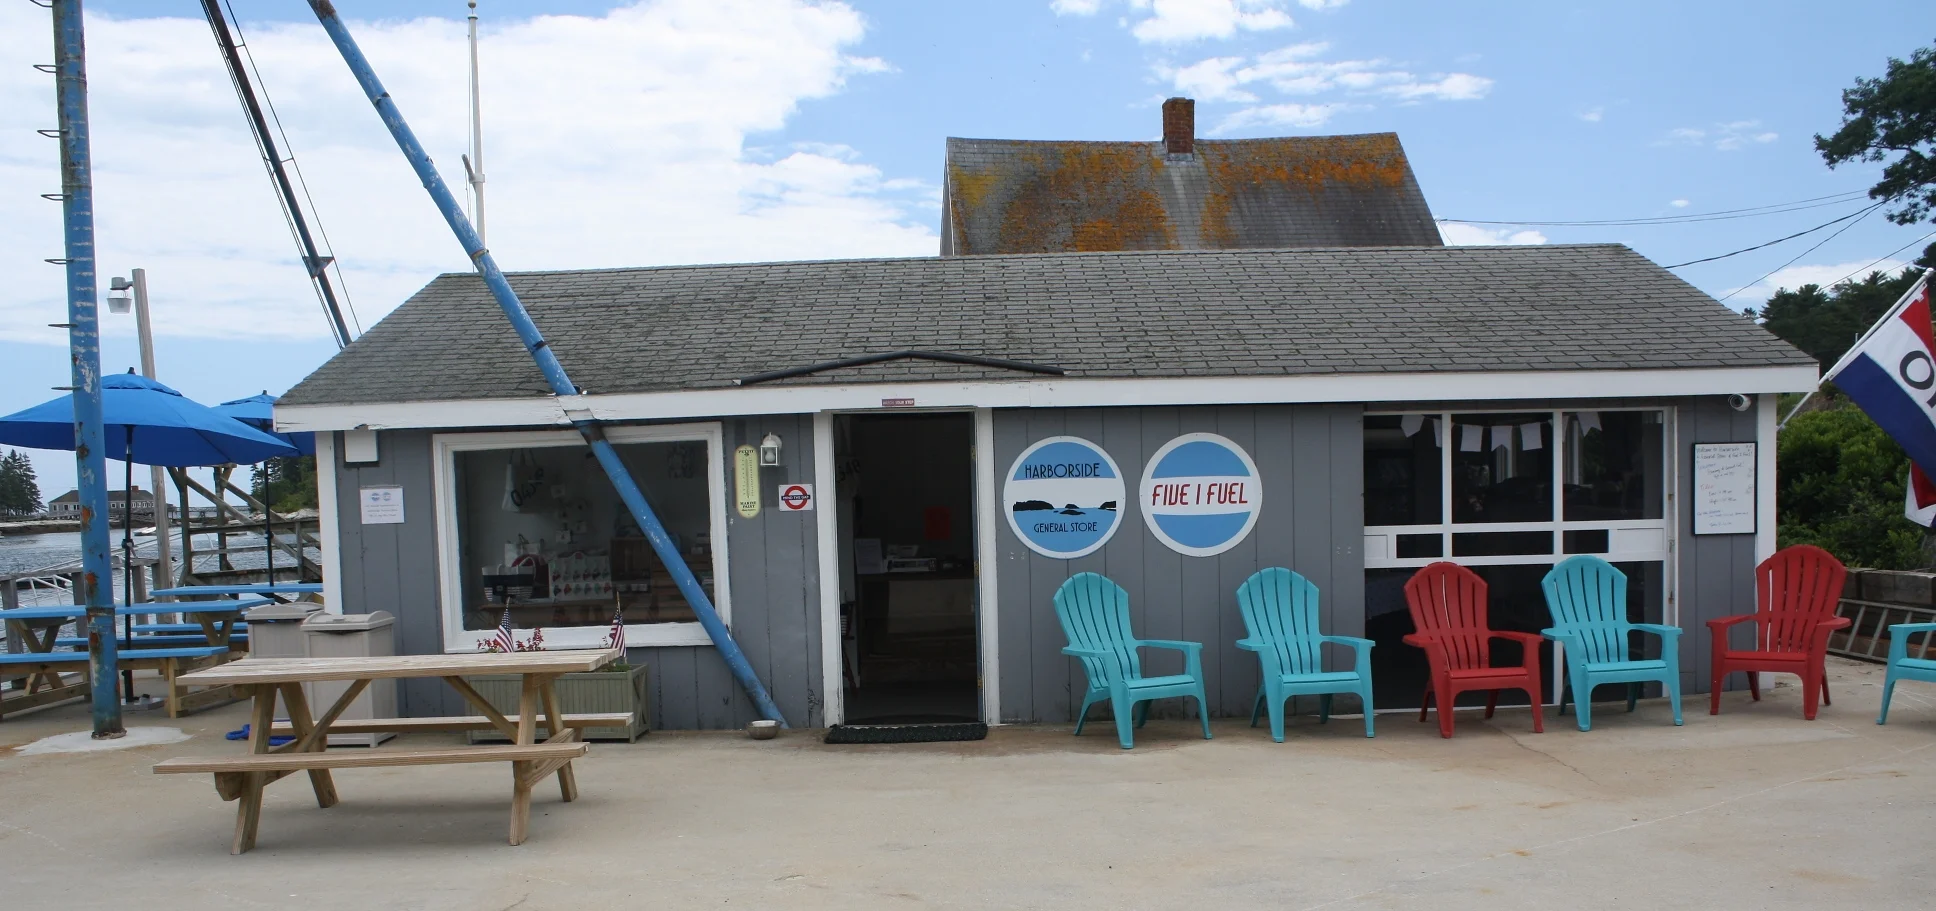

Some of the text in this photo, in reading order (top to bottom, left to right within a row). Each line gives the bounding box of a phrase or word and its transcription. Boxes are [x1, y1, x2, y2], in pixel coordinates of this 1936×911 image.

[1899, 350, 1936, 409] O
[1025, 463, 1100, 478] HARBORSIDE
[1152, 483, 1190, 506] FIVE
[1207, 482, 1248, 505] FUEL
[1034, 522, 1097, 533] GENERAL STORE
